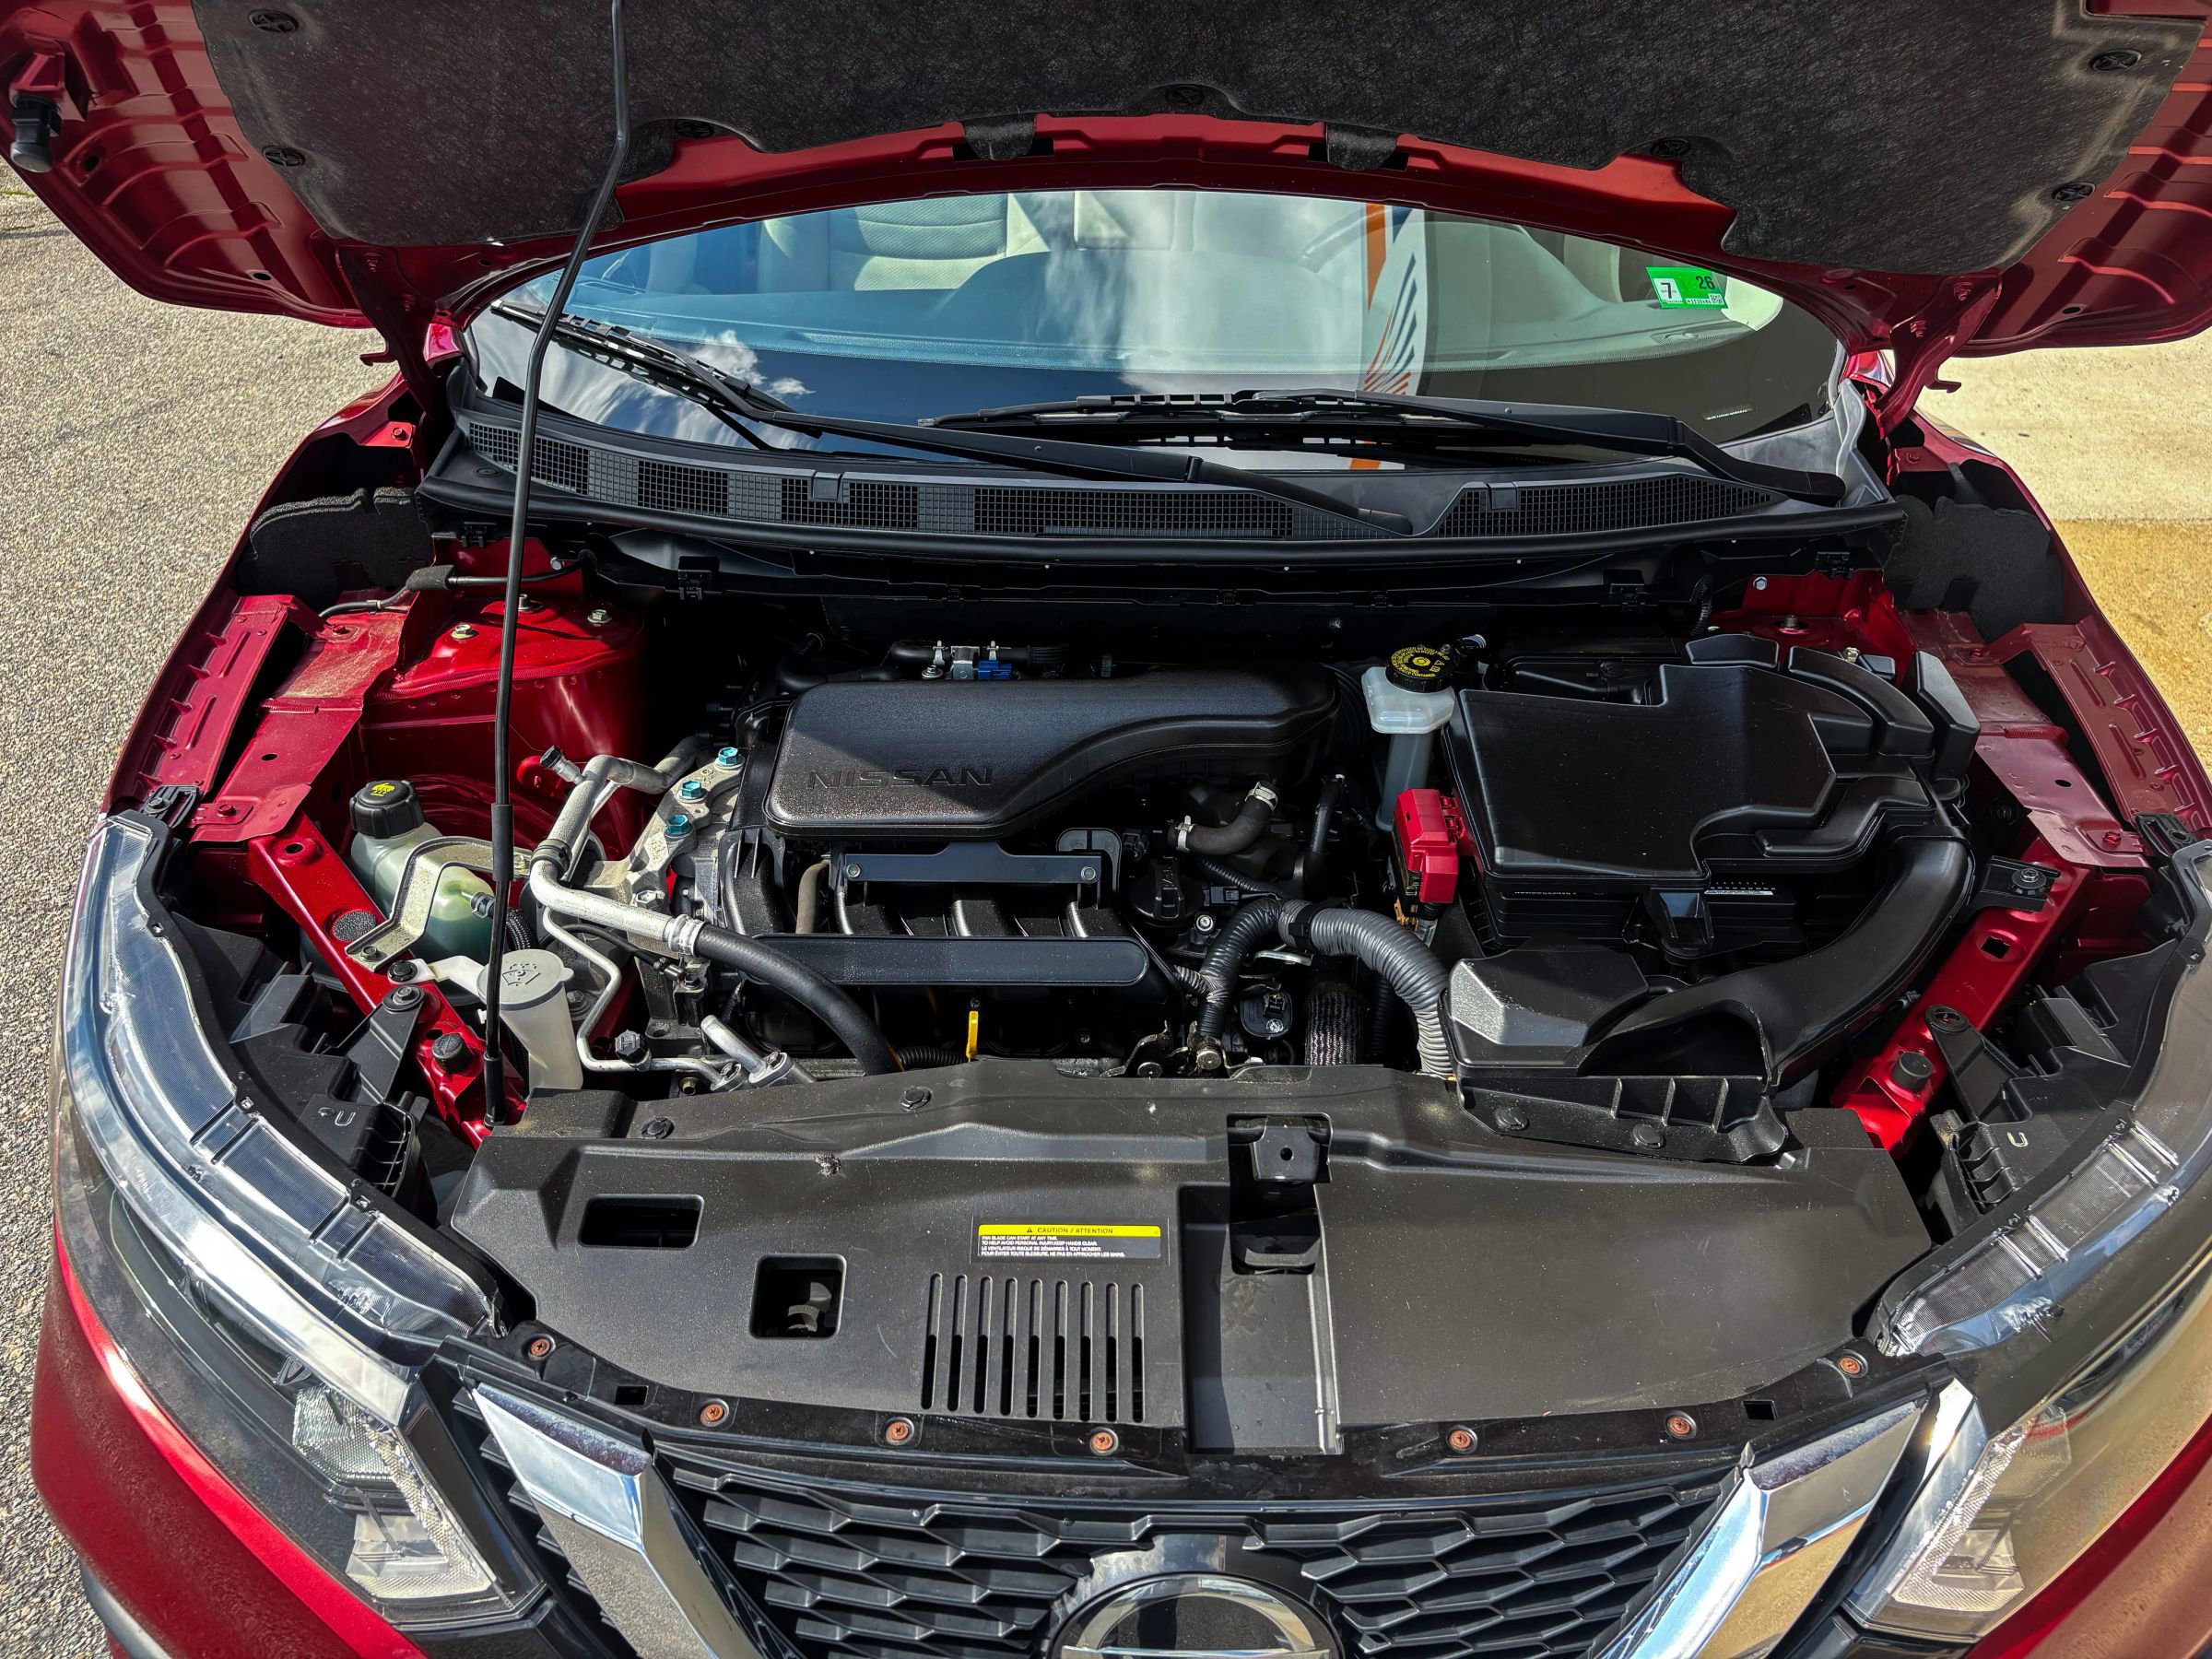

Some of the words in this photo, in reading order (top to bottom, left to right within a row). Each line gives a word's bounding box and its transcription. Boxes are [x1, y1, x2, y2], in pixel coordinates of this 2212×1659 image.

[1661, 282, 1673, 300] 7
[1695, 275, 1715, 290] 26
[806, 766, 994, 790] NISSAN
